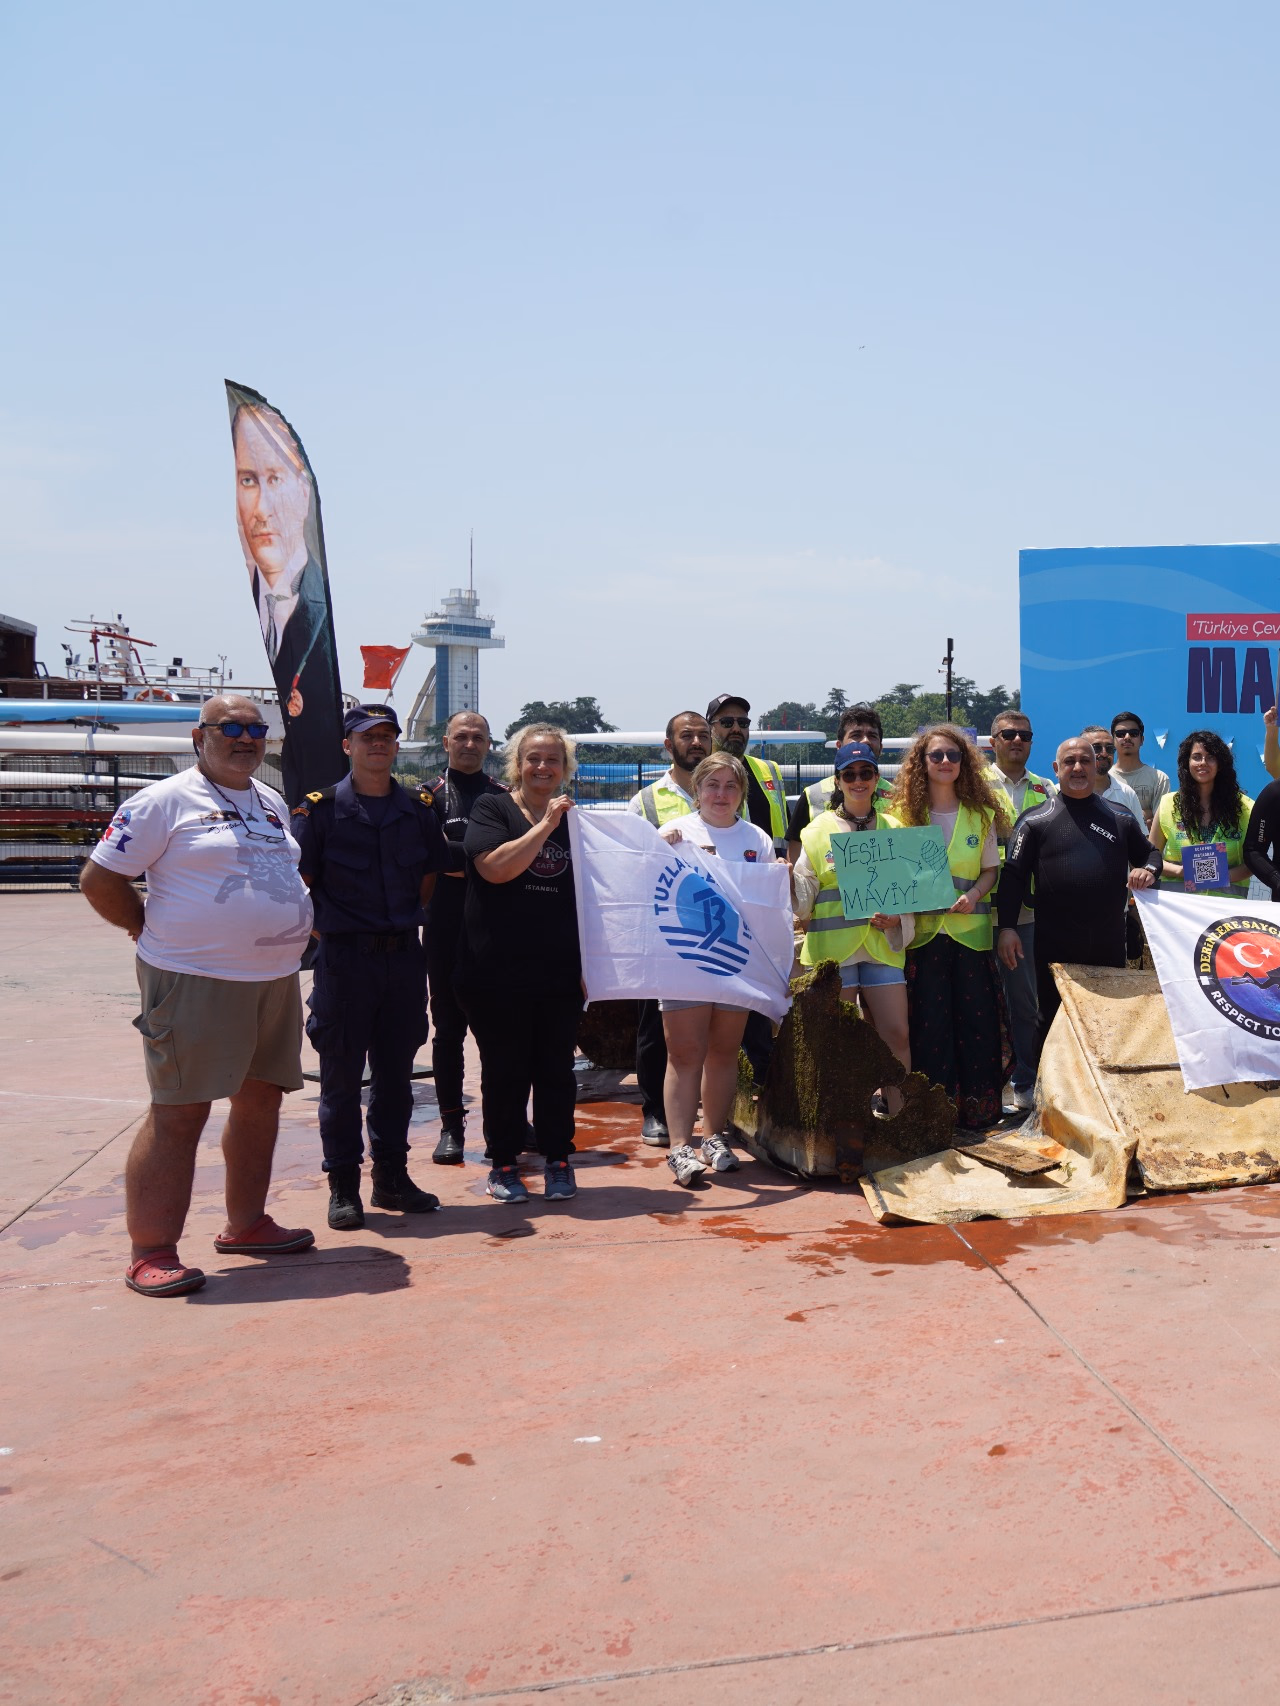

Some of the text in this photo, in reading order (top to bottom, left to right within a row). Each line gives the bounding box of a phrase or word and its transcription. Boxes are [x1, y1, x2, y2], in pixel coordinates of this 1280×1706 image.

[535, 862, 555, 870] CAFE
[833, 837, 896, 868] YEŞİLİ
[525, 884, 559, 893] ISTANBUL
[654, 857, 686, 916] TUZLA
[843, 880, 918, 914] MAVİYİ
[1210, 990, 1261, 1031] RESPECT
